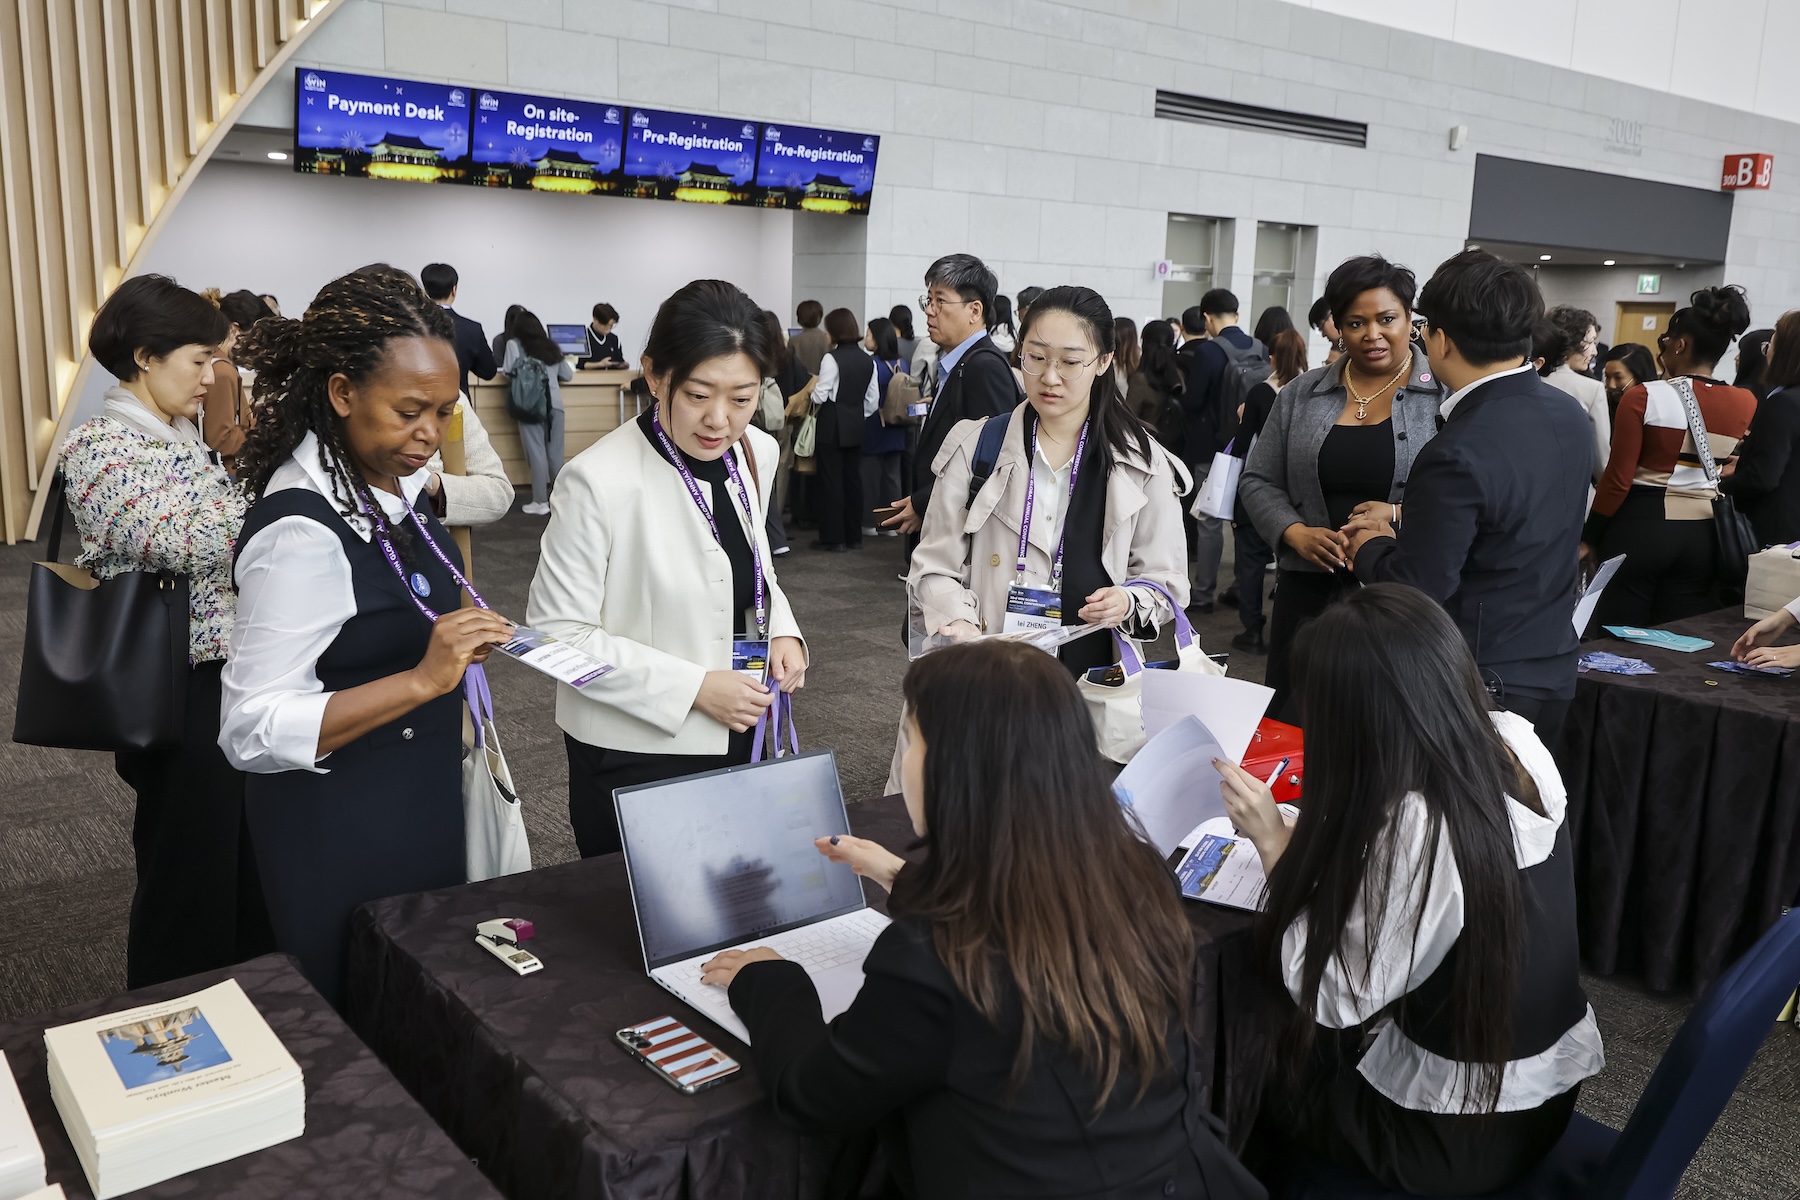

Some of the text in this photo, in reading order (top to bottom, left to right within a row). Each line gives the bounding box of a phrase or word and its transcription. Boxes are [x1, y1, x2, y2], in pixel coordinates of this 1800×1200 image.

[328, 94, 444, 122] Payment Desk
[523, 103, 580, 123] On site-
[506, 120, 593, 143] Registration
[642, 128, 743, 152] Pre-Registration
[773, 142, 864, 164] Pre-Registration
[1737, 158, 1754, 187] B
[1762, 158, 1772, 187] B
[658, 431, 685, 470] CONFERENCE
[1072, 441, 1085, 475] CONFERENCE
[725, 457, 736, 472] 33rd
[682, 470, 700, 496] ANNUAL
[696, 496, 712, 520] GLOBAL
[429, 541, 451, 565] ANNUAL
[393, 560, 403, 577] WIN
[449, 564, 469, 585] GLOBAL
[466, 585, 478, 598] WIN
[1026, 621, 1047, 630] ZHENG
